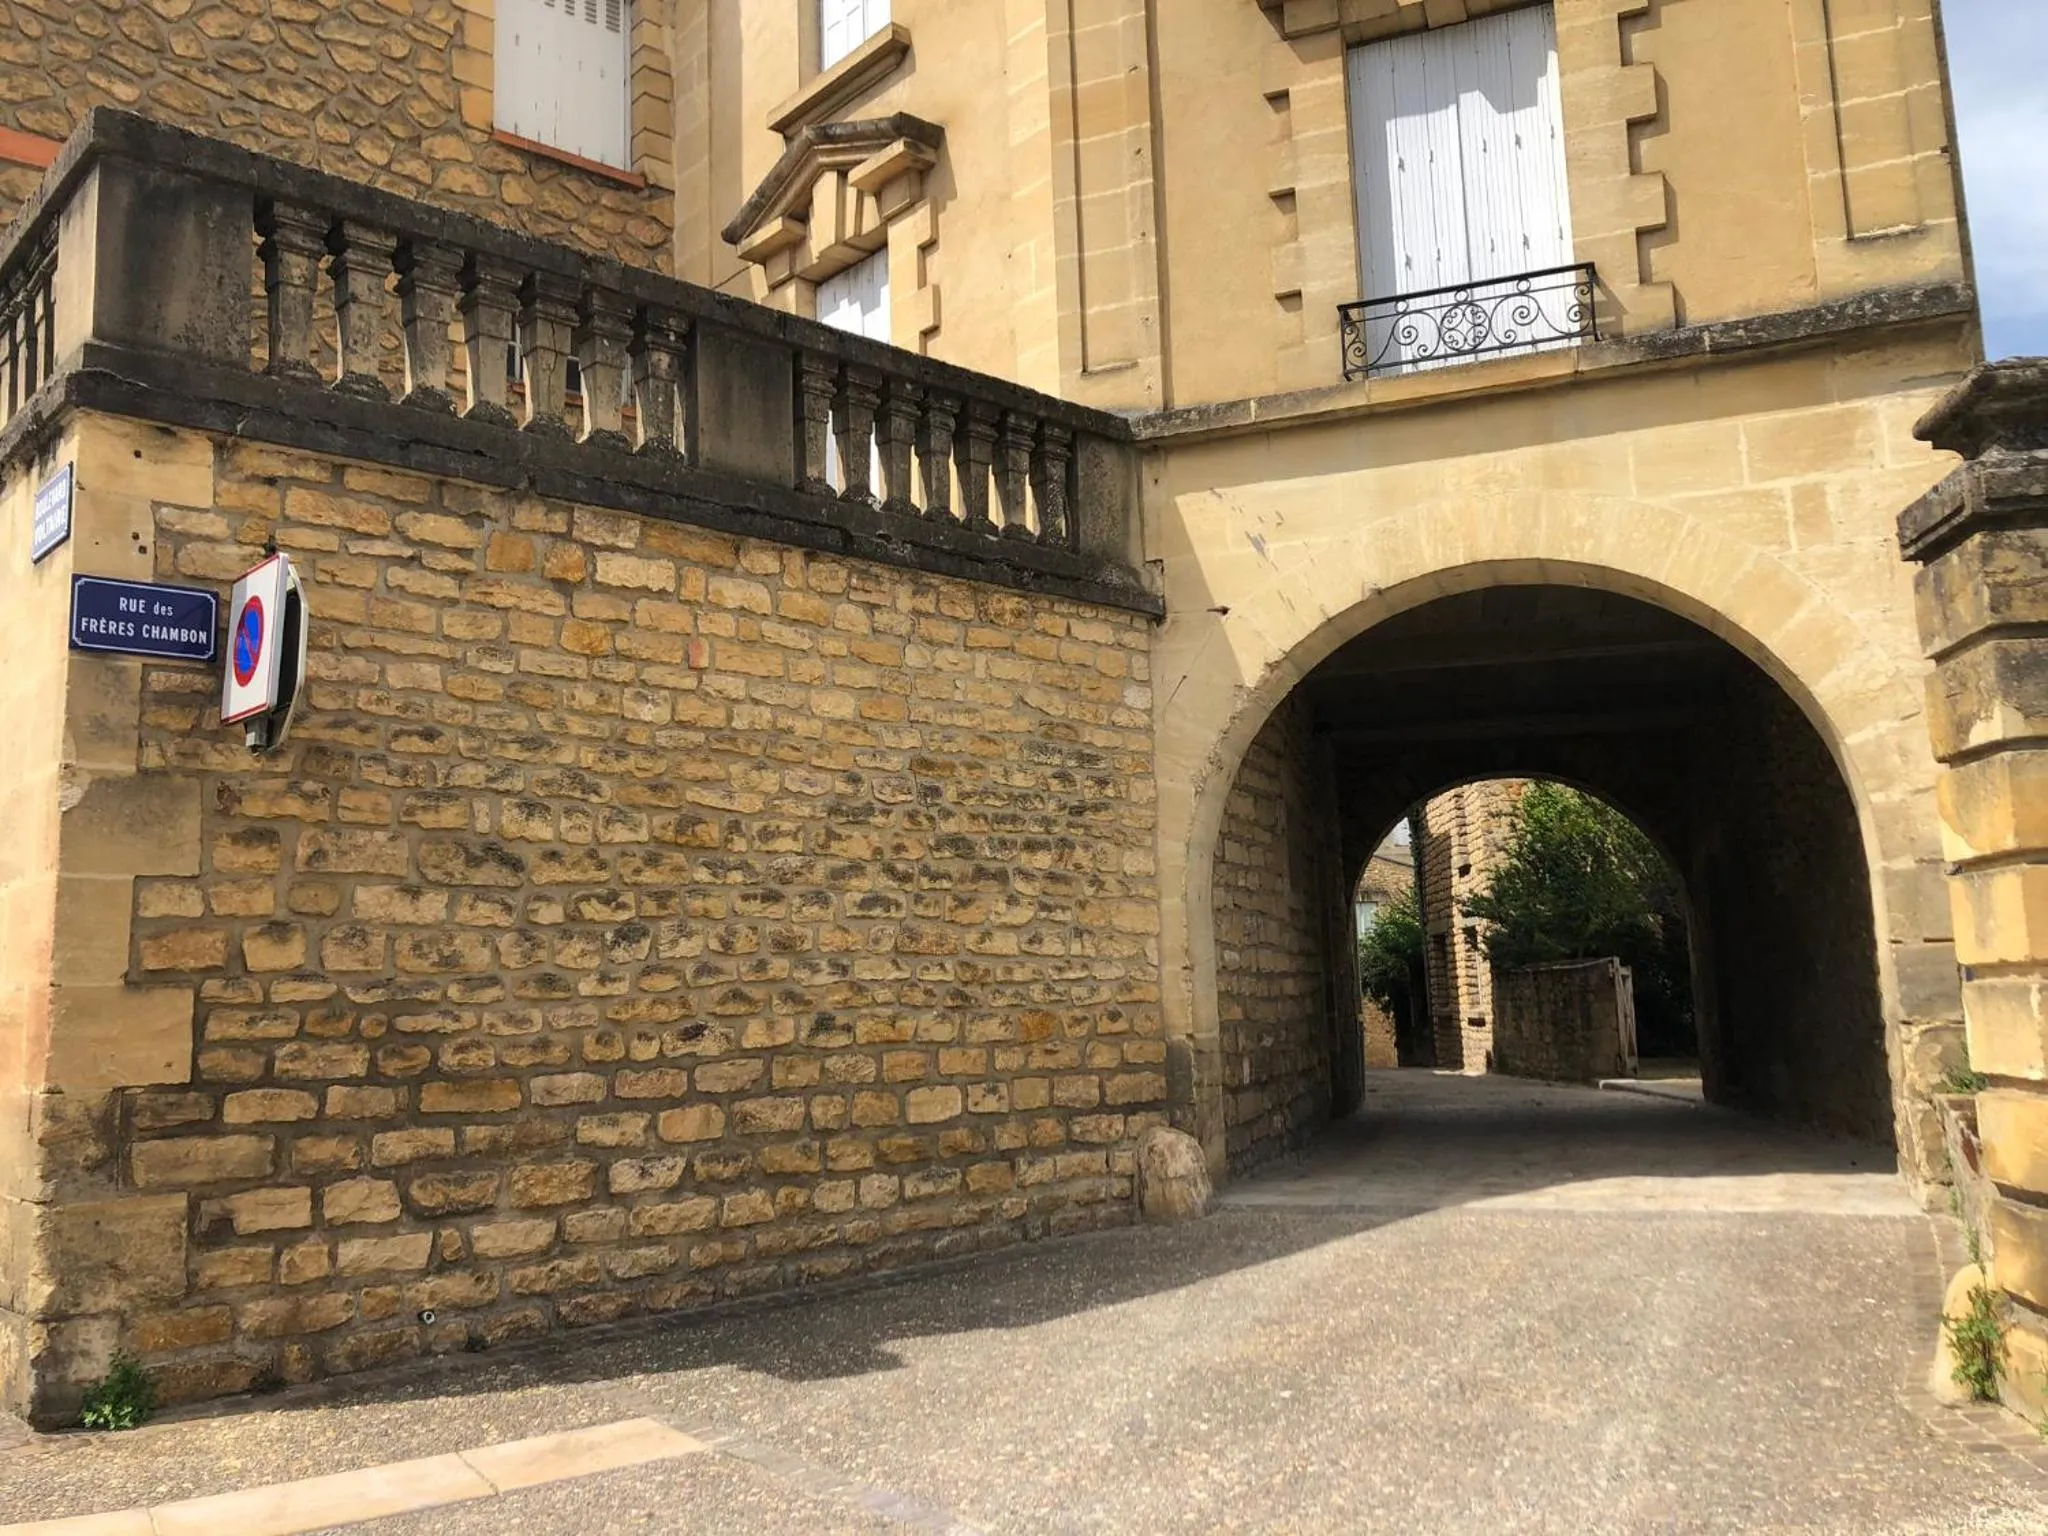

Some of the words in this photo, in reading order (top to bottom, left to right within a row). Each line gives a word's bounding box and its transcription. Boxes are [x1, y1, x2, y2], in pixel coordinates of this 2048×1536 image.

[119, 597, 146, 614] RUE
[153, 602, 174, 617] des
[81, 617, 135, 637] FRÈRES
[142, 624, 207, 644] CHAMBON
